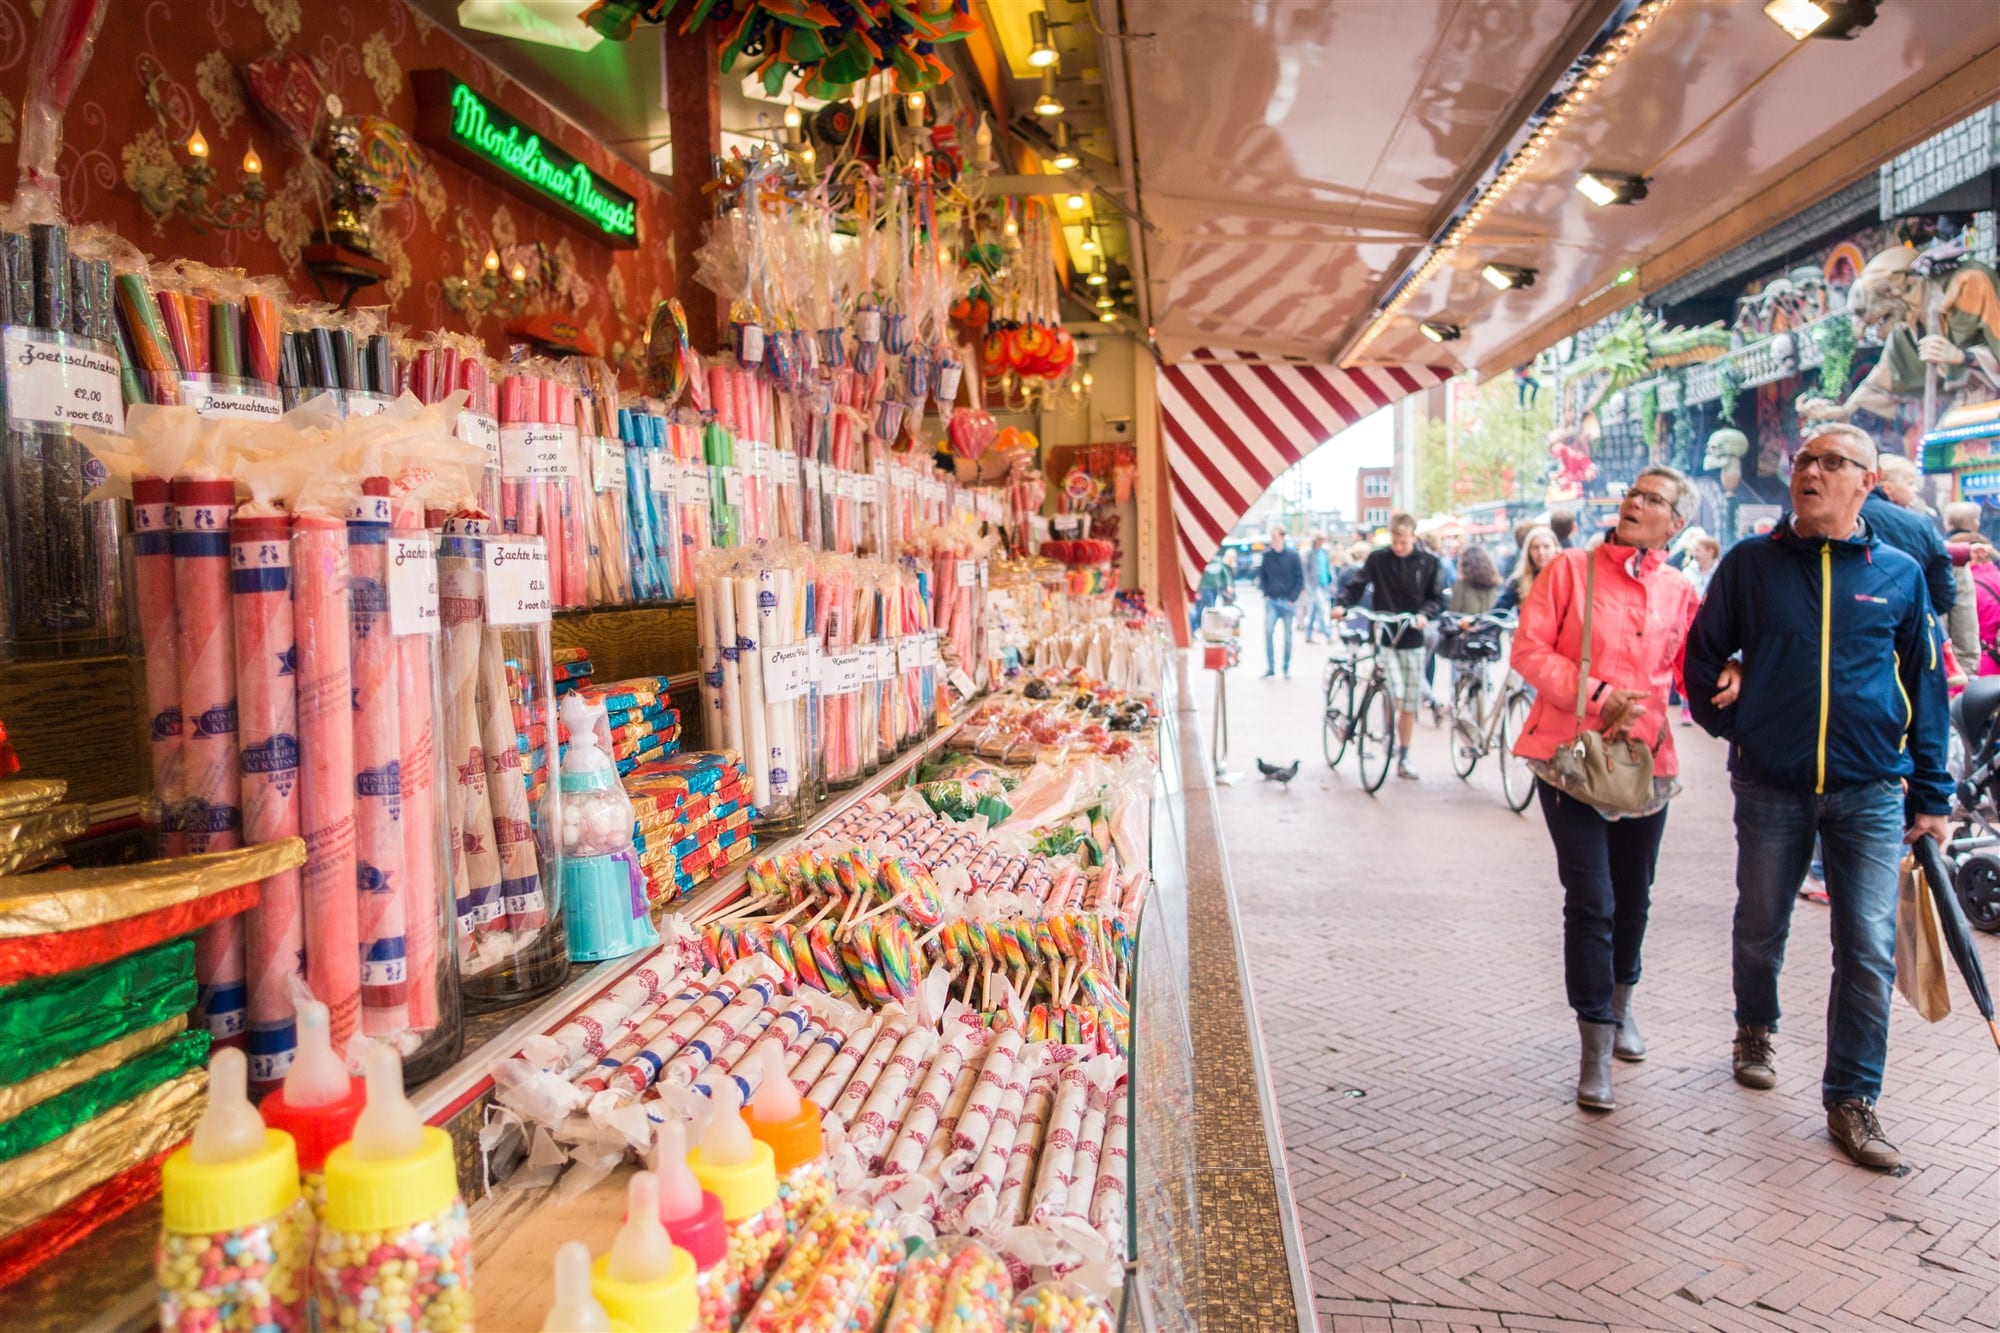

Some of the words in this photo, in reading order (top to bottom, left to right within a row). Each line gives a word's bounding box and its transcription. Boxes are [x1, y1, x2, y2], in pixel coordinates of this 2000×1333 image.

[451, 84, 576, 202] Montelimar
[571, 162, 636, 236] Nougat
[74, 387, 102, 402] €2,00
[54, 405, 64, 417] 3
[66, 410, 90, 420] voor
[91, 411, 114, 425] €5,00
[493, 546, 531, 566] Zachte
[517, 599, 524, 610] 2
